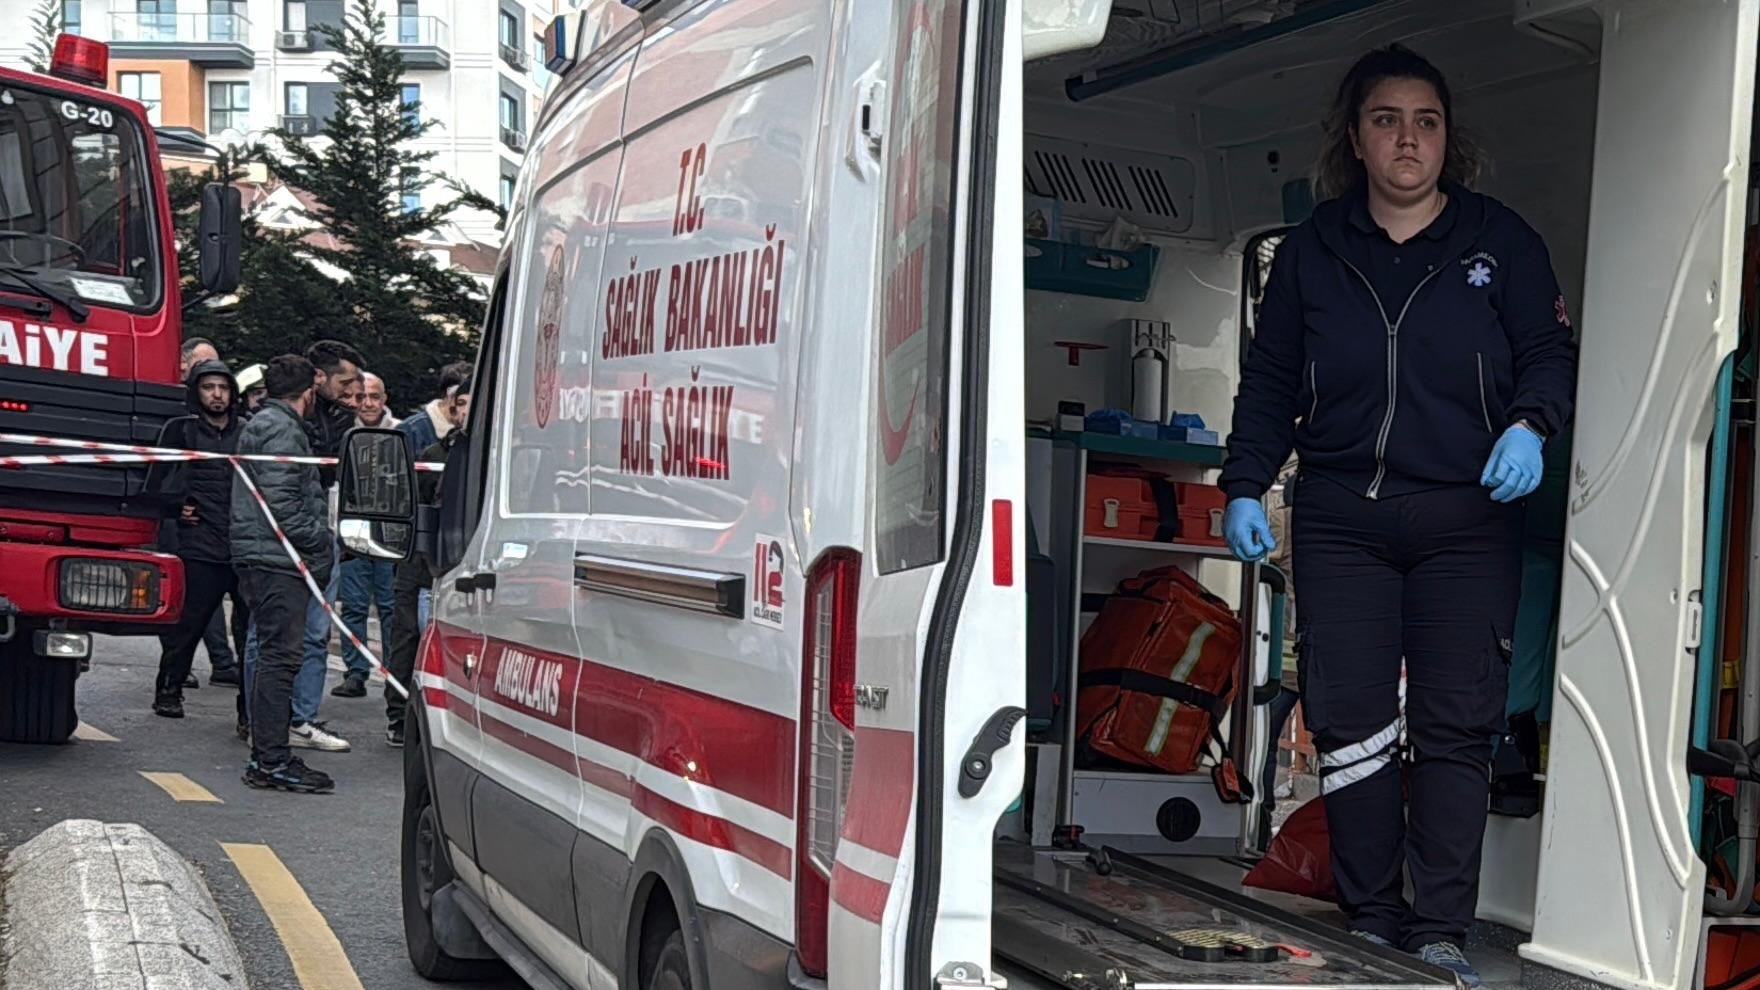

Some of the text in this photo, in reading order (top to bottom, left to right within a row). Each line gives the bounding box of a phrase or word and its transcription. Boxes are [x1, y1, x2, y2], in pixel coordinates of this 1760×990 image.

[61, 101, 114, 128] G-20
[602, 255, 661, 360] SAĞLIK
[664, 223, 785, 352] BAKANLIĞI
[620, 365, 734, 480] ACİL SAĞLIK
[494, 646, 563, 717] AMBULANS
